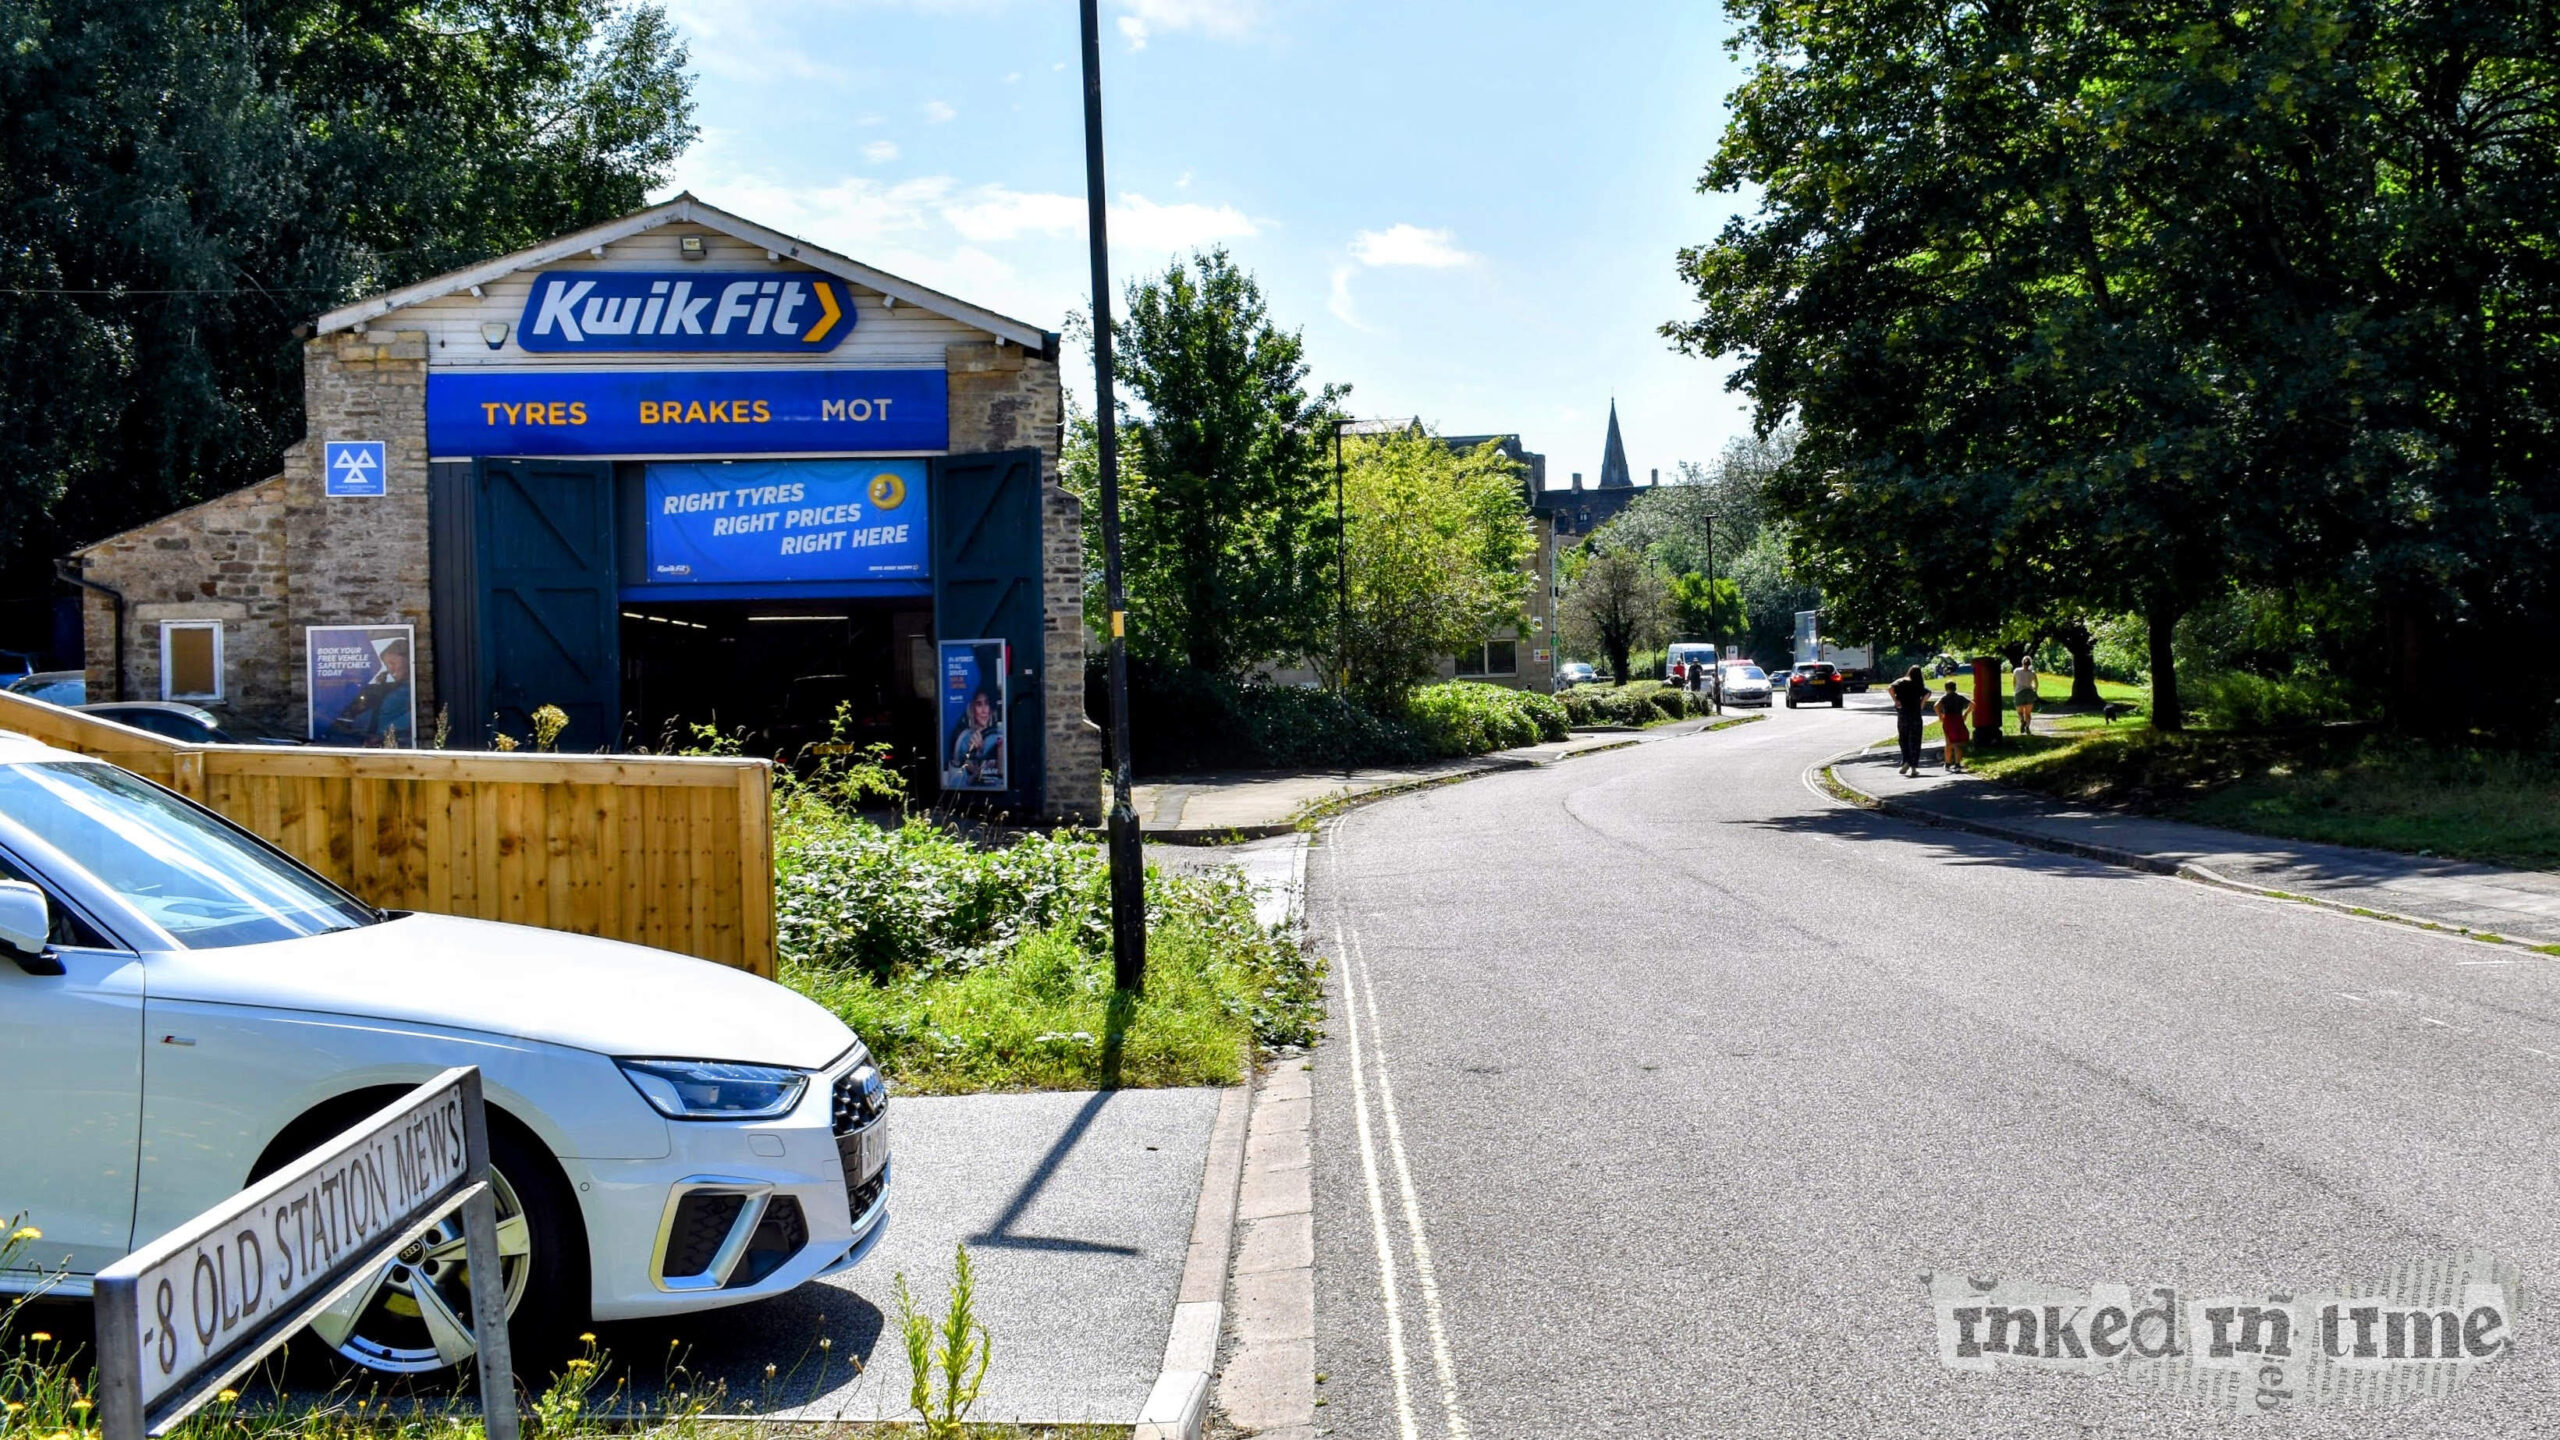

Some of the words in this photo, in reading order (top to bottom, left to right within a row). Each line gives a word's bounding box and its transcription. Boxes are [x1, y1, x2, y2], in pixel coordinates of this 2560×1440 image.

[481, 402, 588, 426] TYRES
[640, 400, 771, 424] BRAKES
[822, 398, 893, 422] MOT
[664, 491, 730, 514] RIGHT
[736, 483, 805, 508] TYRES
[713, 512, 779, 536] RIGHT
[785, 503, 862, 529] PRICES
[780, 531, 846, 555] RIGHT
[852, 524, 909, 548] HERE
[337, 654, 369, 662] VEHICLE
[340, 647, 362, 655] YOUR
[347, 661, 371, 669] CHECK
[193, 1229, 264, 1346] OLD
[275, 1144, 390, 1290] STATION
[394, 1100, 464, 1207] MEWS
